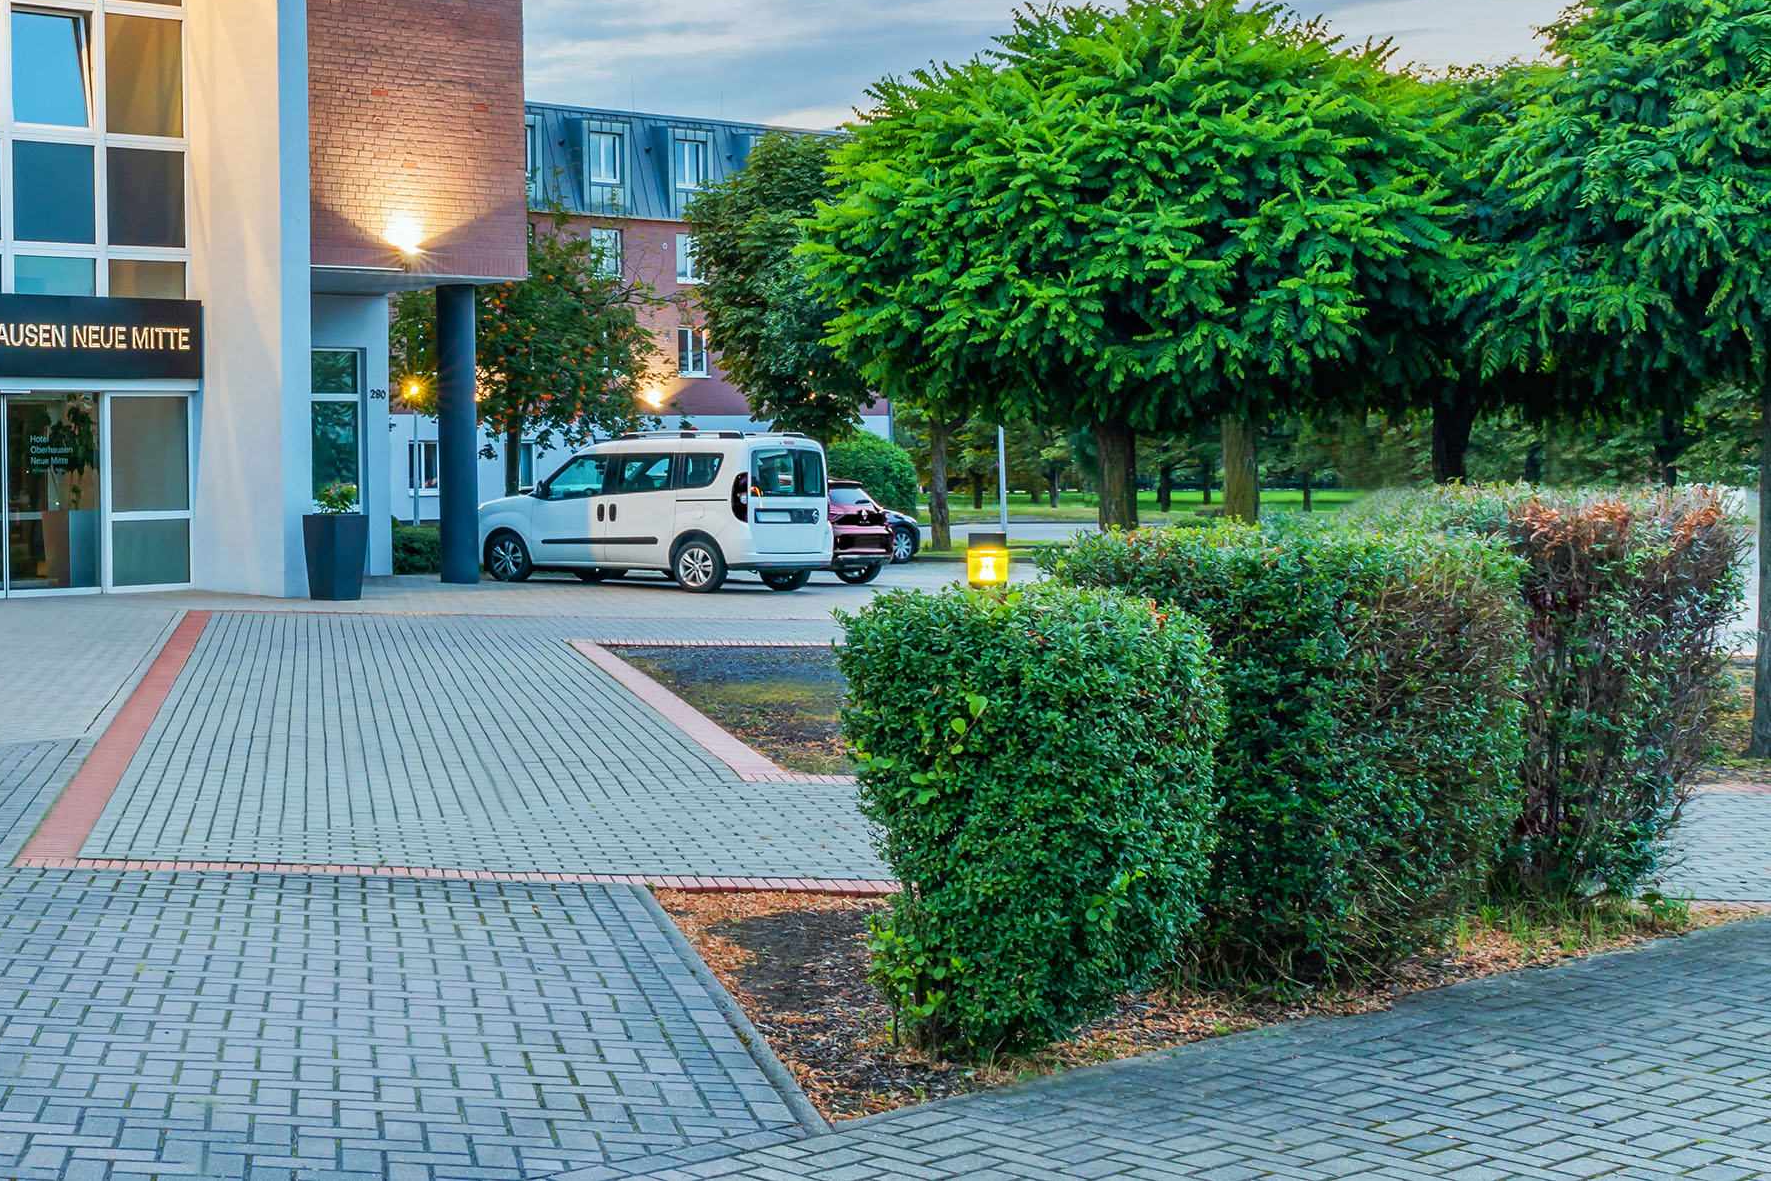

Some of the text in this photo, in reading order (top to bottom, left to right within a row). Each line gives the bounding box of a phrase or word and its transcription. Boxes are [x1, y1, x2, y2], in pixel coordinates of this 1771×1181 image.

[73, 325, 127, 349] NEUE
[132, 327, 191, 350] MITTE
[370, 388, 387, 400] 280
[30, 434, 50, 443] Hotel
[30, 445, 74, 454] Oberhausen
[30, 457, 69, 465] Neue Mitte
